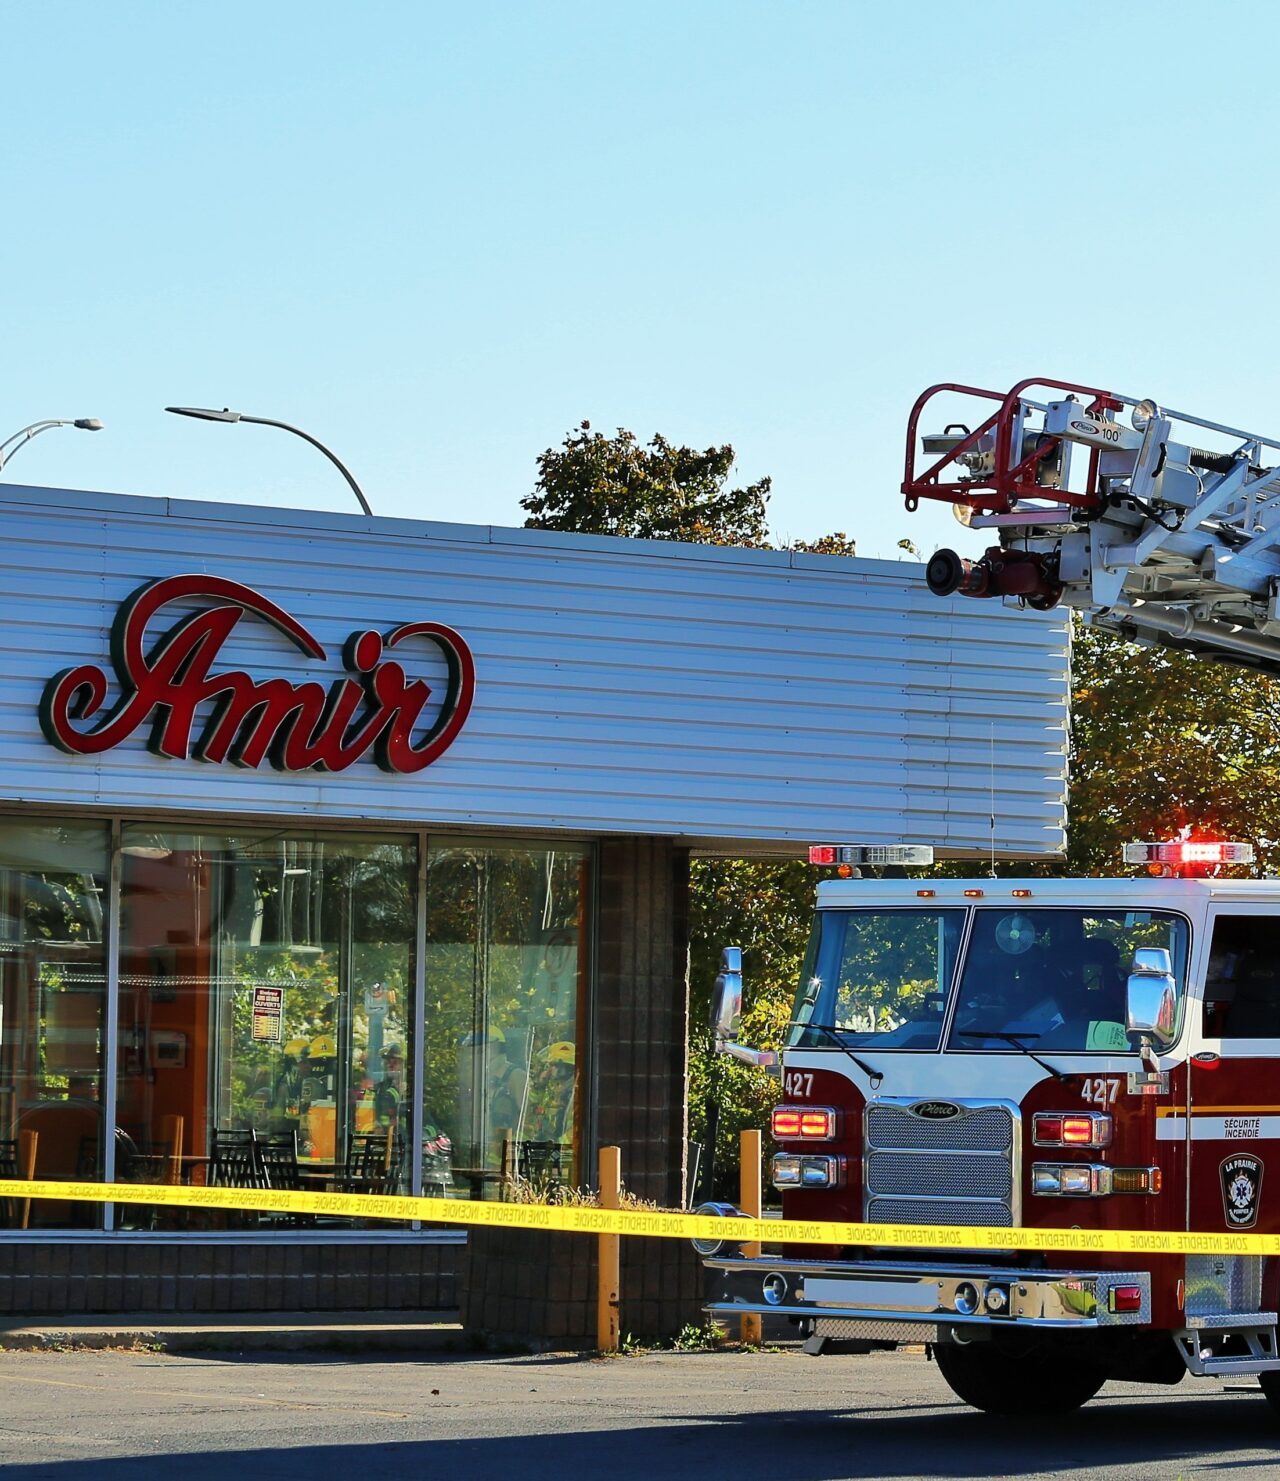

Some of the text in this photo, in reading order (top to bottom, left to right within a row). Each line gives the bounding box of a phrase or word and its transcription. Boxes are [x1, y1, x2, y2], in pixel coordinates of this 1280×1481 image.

[39, 573, 477, 774] Amir
[786, 1073, 814, 1097] 427
[1081, 1079, 1120, 1103] 427
[1224, 1118, 1260, 1128] SÉCURITÉ
[1225, 1129, 1259, 1138] INCENDIE
[1225, 1160, 1257, 1172] LA PRAIRIE
